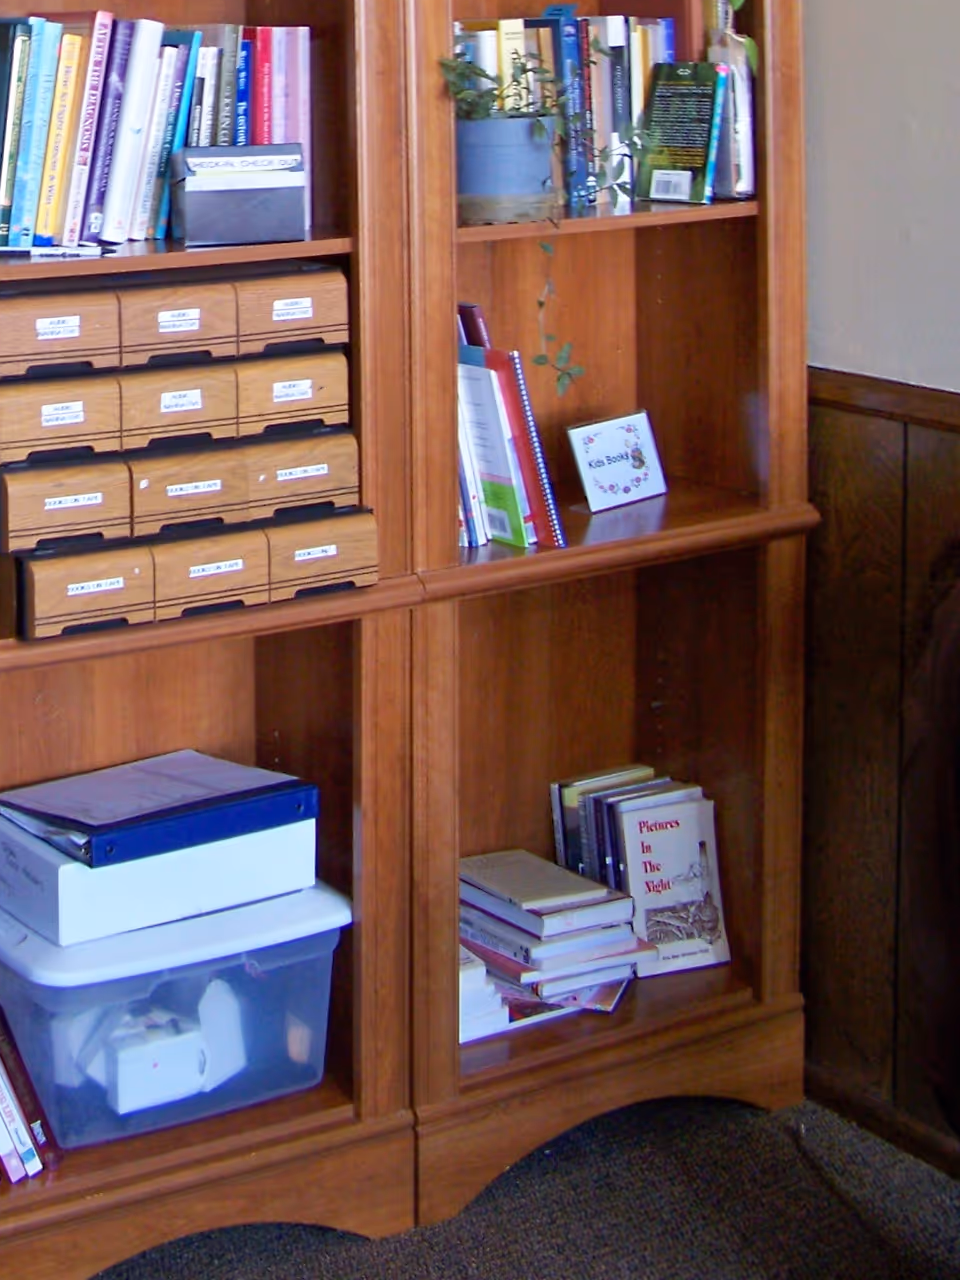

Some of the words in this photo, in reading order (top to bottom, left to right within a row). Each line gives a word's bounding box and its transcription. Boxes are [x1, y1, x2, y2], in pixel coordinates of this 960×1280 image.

[81, 89, 101, 150] DIAGNOSIS
[588, 455, 604, 469] Kids
[605, 452, 630, 465] Books
[638, 818, 680, 834] Pictures
[640, 841, 652, 853] In
[642, 861, 662, 873] The
[644, 880, 672, 895] Night
